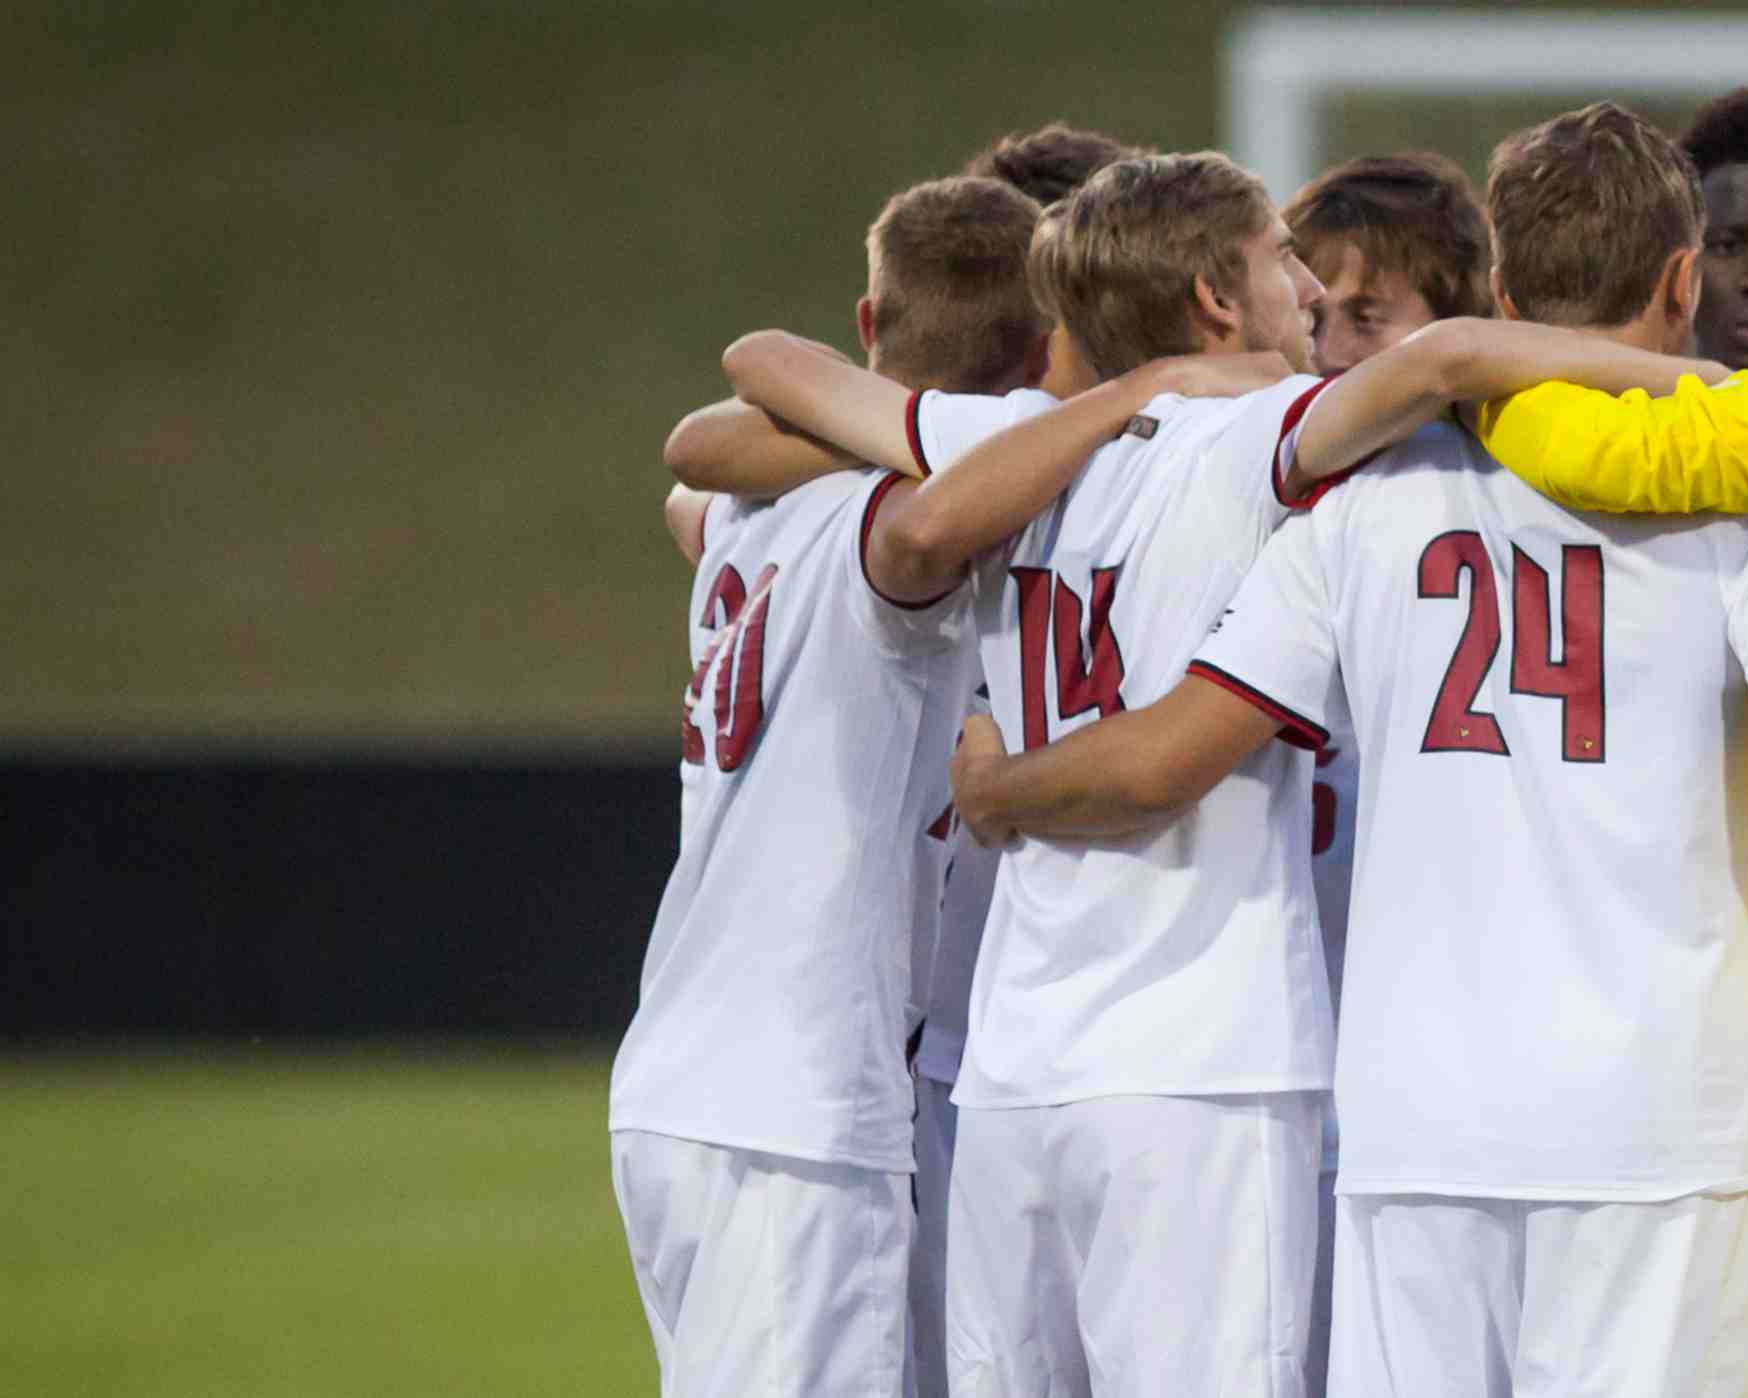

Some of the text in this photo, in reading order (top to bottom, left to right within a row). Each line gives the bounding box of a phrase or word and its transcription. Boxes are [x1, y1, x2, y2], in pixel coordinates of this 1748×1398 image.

[682, 562, 778, 773] 20
[1008, 564, 1128, 753] 14
[1416, 529, 1607, 764] 24
